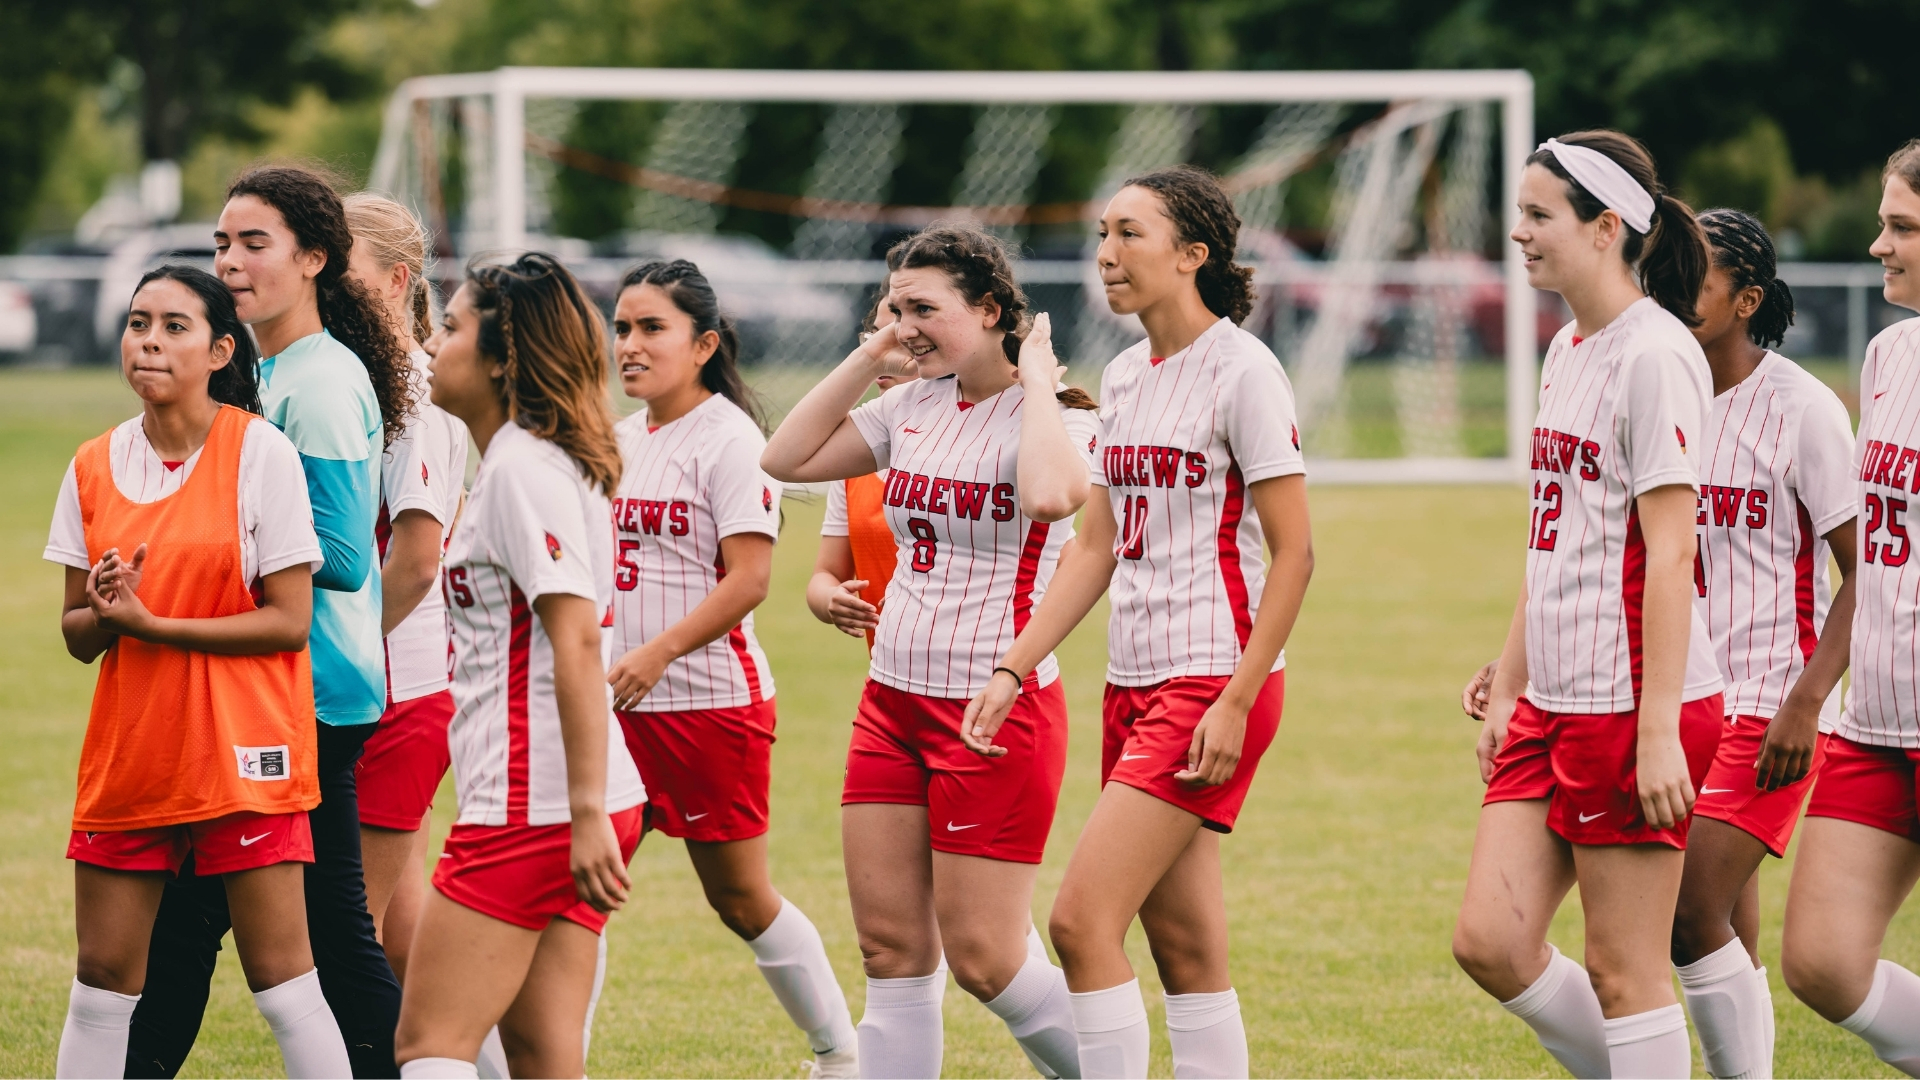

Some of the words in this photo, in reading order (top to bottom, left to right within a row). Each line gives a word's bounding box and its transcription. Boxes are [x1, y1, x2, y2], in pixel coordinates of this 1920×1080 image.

[906, 517, 939, 573] 8
[1865, 492, 1911, 568] 25
[442, 565, 475, 609] S
[616, 539, 640, 591] 5
